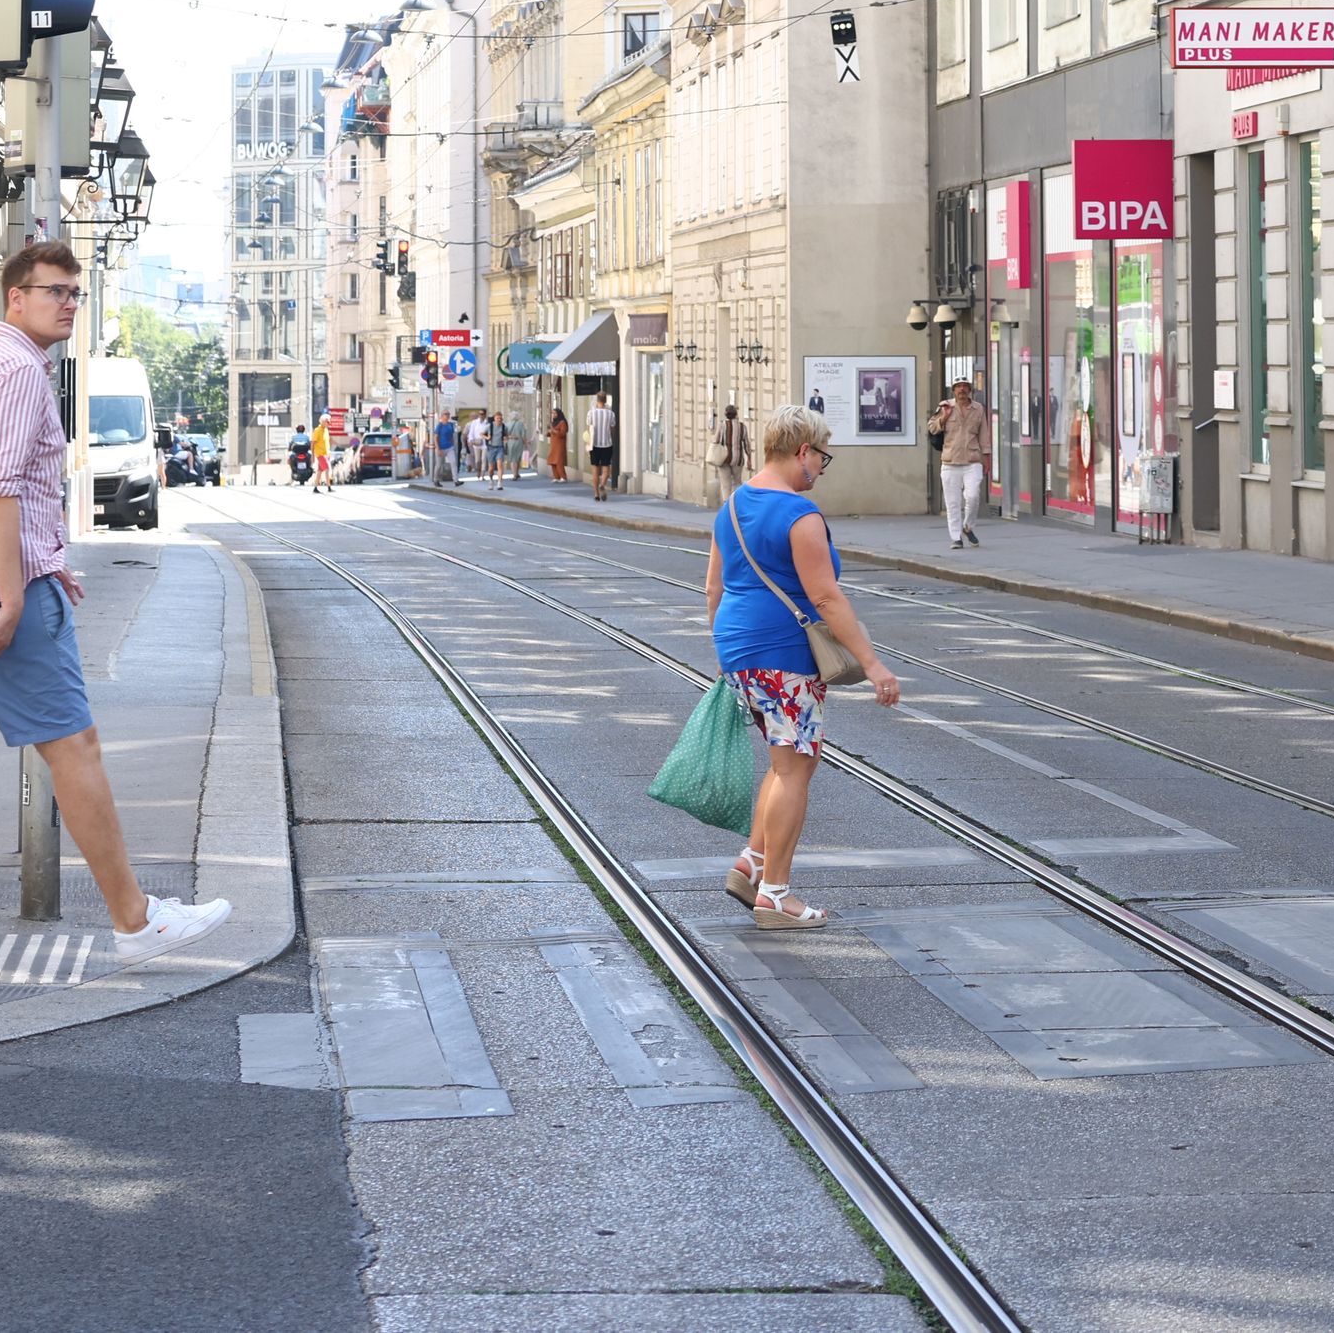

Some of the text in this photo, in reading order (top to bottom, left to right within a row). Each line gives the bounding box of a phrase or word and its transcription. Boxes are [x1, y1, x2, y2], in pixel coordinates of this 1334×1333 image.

[1178, 21, 1242, 42] MANI
[1184, 48, 1233, 61] PLUS
[1233, 114, 1251, 136] PLUS
[237, 141, 288, 160] BUWOG
[1081, 200, 1169, 231] BIPA
[438, 334, 465, 342] Astoria
[497, 380, 523, 388] SPA
